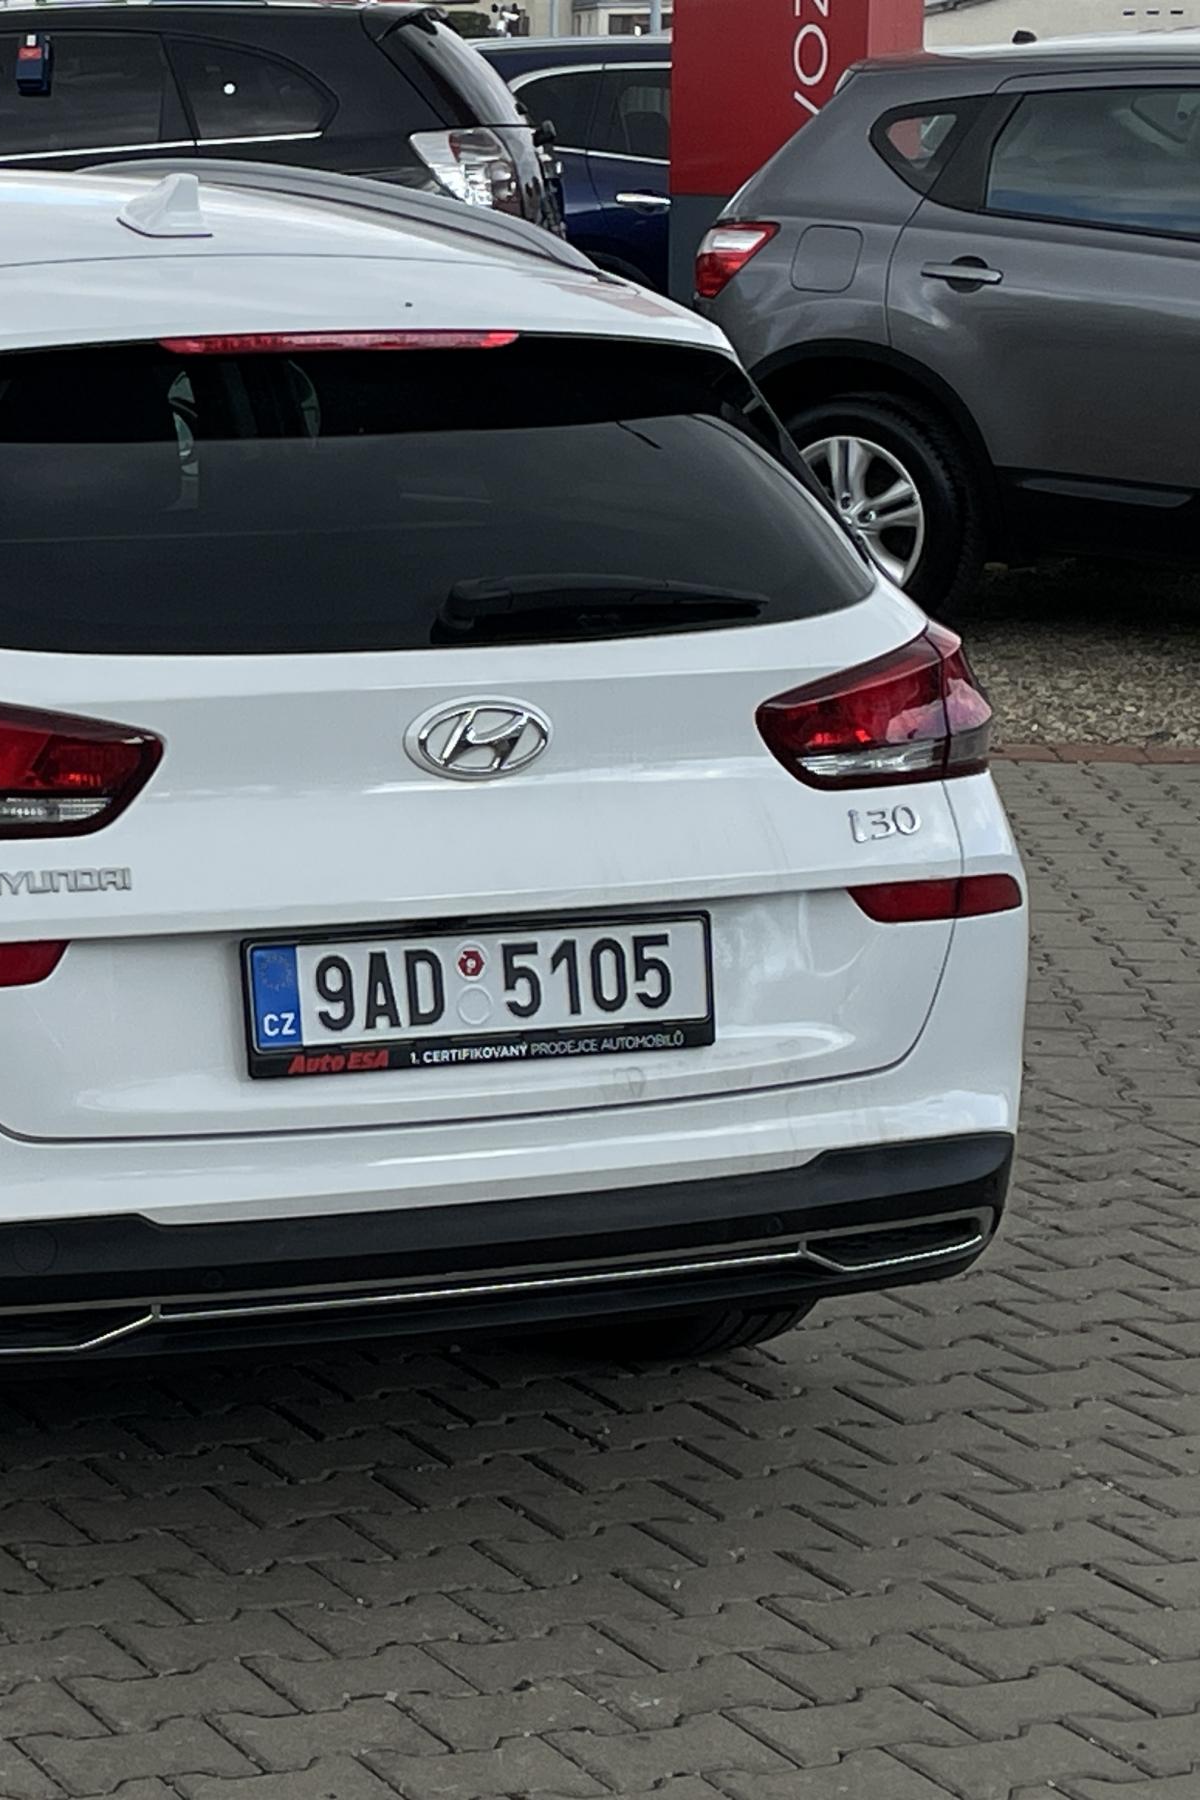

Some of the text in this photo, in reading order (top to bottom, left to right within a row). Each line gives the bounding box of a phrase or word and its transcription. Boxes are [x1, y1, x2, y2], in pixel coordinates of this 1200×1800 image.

[315, 933, 672, 1032] 9AD 5105
[263, 1012, 297, 1036] CZ
[423, 1041, 528, 1063] CERTIFIKOVANÝ
[531, 1039, 598, 1055] PRODEJCE
[601, 1030, 684, 1050] AUTOMOBILŮ
[288, 1049, 389, 1074] Auto ESA
